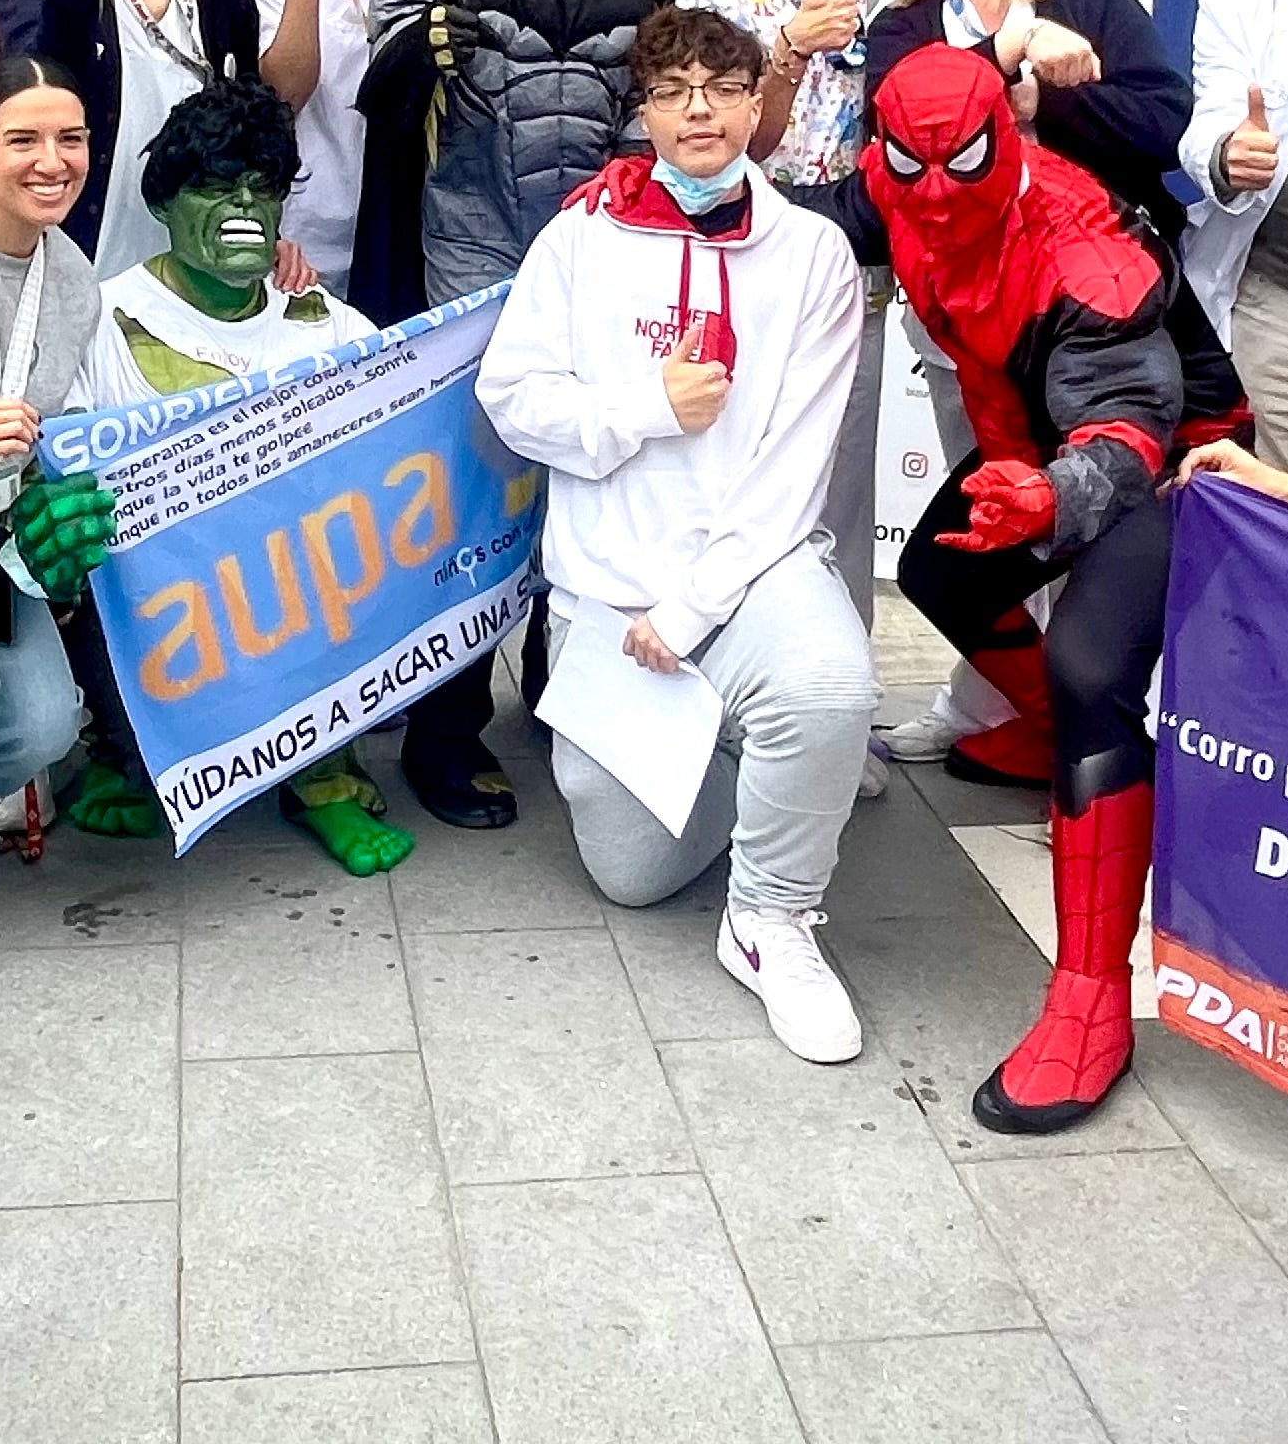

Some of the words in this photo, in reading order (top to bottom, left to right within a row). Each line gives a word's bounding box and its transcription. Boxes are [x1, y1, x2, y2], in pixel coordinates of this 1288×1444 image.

[112, 468, 169, 499] stros
[220, 418, 277, 455] menos
[208, 420, 229, 437] es
[232, 403, 250, 425] el
[251, 384, 299, 418] mejor
[103, 511, 160, 547] unque
[165, 500, 190, 519] no
[196, 473, 249, 505] todos
[255, 458, 282, 479] los
[287, 406, 384, 463] amaneceres
[389, 387, 425, 413] sean
[113, 493, 156, 523] nque
[163, 479, 182, 499] la
[186, 461, 227, 488] vida
[232, 448, 251, 468] te
[256, 421, 314, 462] golpee
[137, 448, 457, 704] aupa
[164, 713, 318, 825] YÚDANOS
[328, 699, 352, 733] A
[359, 632, 457, 715] SACAR
[458, 603, 512, 650] UNA
[1154, 964, 1264, 1054] PDA
